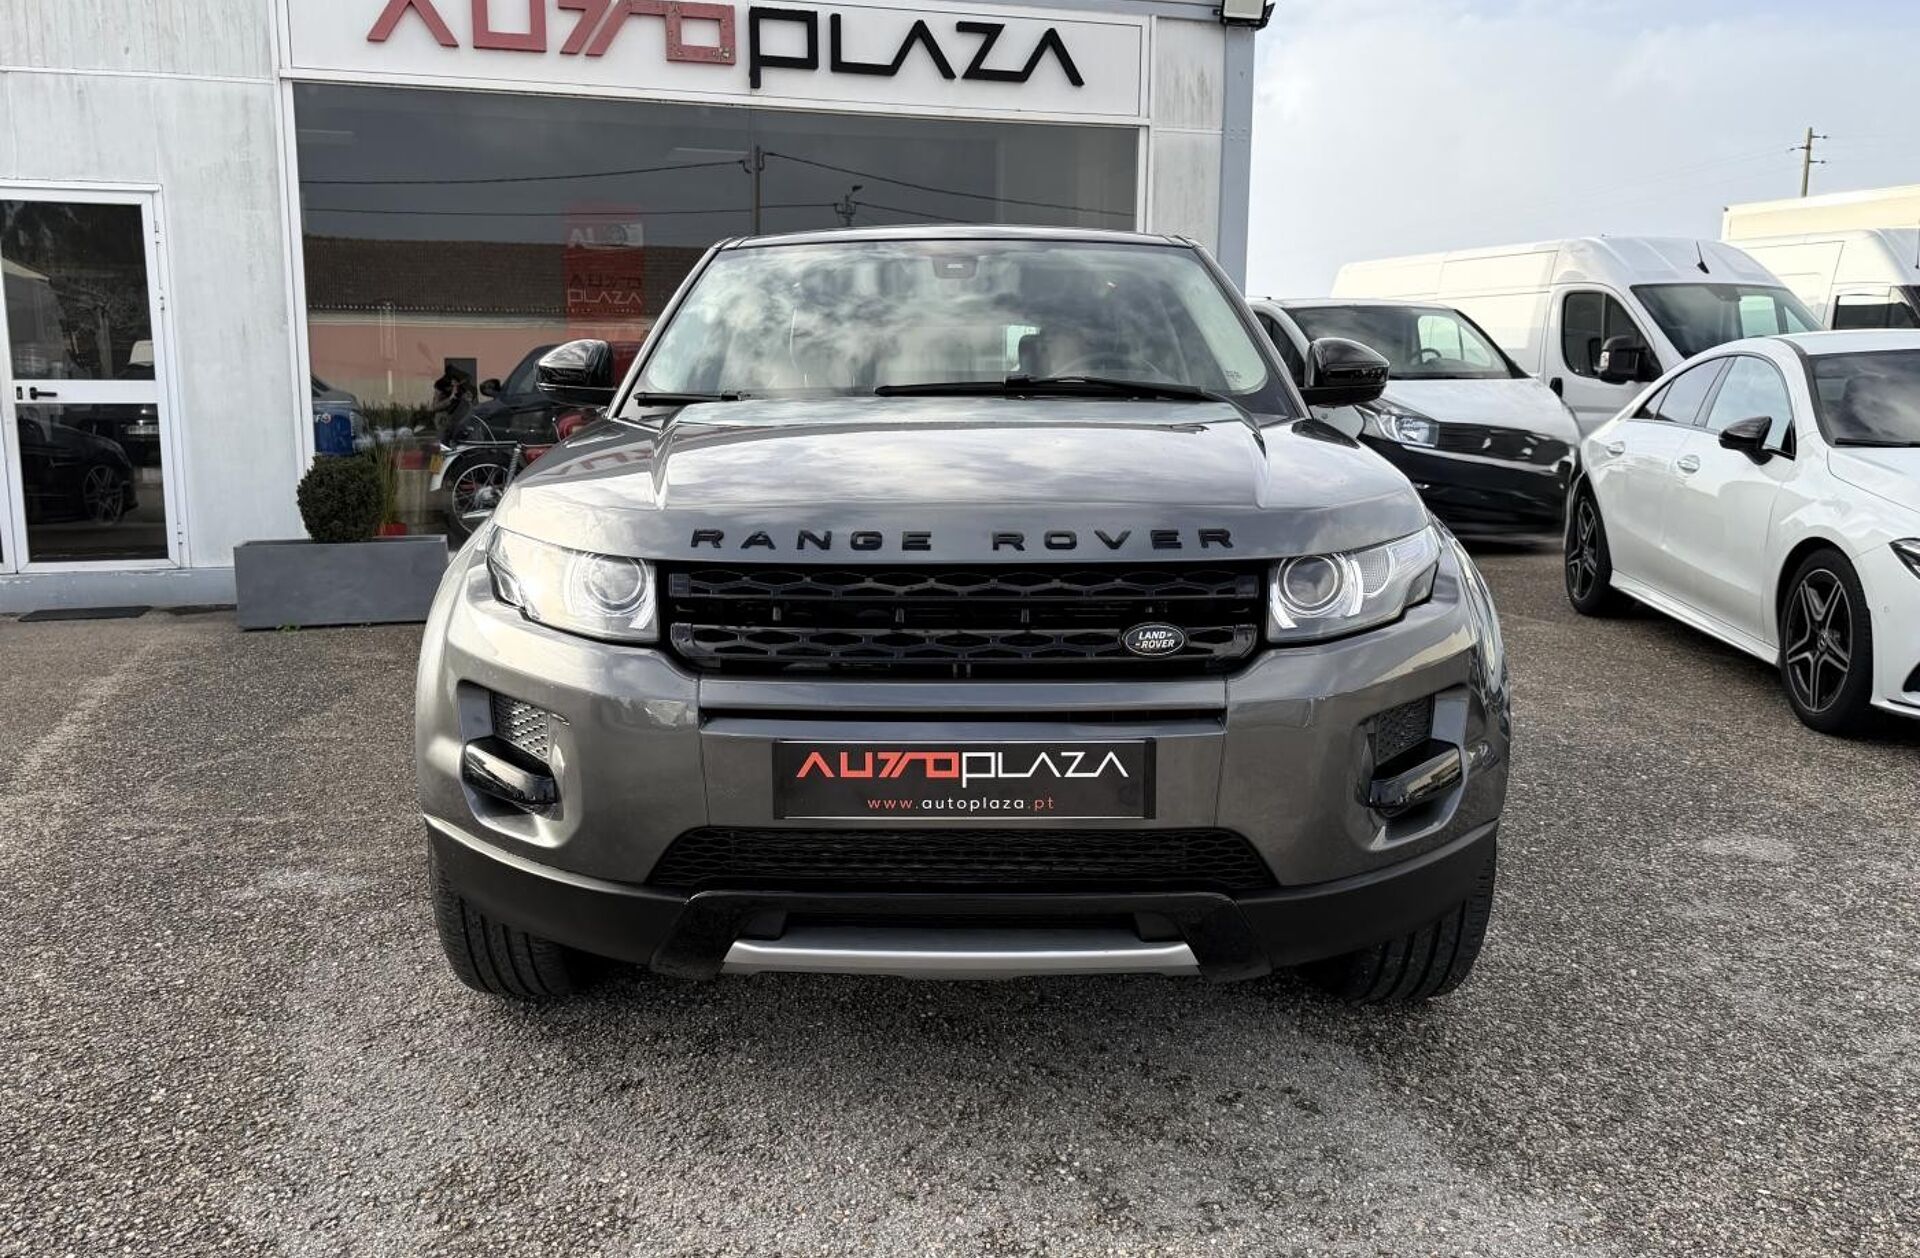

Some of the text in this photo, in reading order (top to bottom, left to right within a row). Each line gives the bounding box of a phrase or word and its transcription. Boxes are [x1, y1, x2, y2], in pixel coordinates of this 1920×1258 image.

[567, 287, 643, 306] PLAZA
[690, 528, 1234, 551] RANGE ROVER
[867, 796, 1056, 812] www.autoplaza.pt
